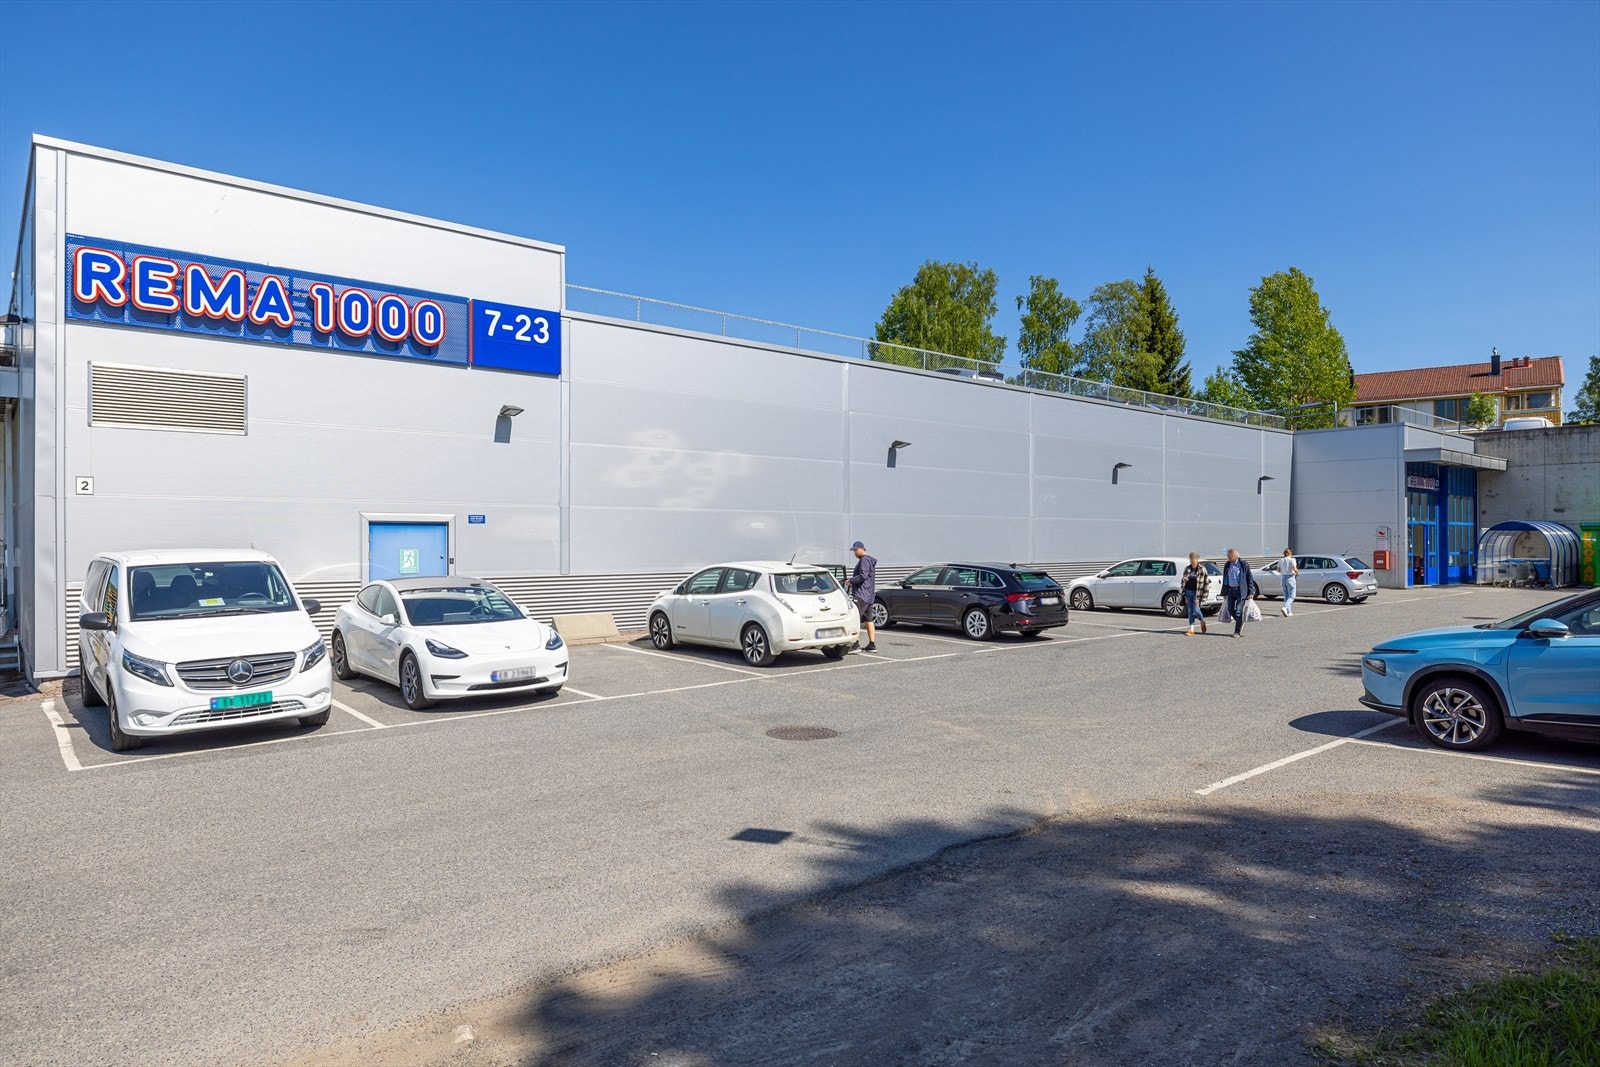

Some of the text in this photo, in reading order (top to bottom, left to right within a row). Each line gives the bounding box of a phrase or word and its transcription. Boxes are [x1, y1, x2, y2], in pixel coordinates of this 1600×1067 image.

[73, 247, 447, 347] REMA 1000
[485, 309, 551, 345] 7-23
[81, 480, 89, 491] 2
[1583, 531, 1594, 582] PROPAN
